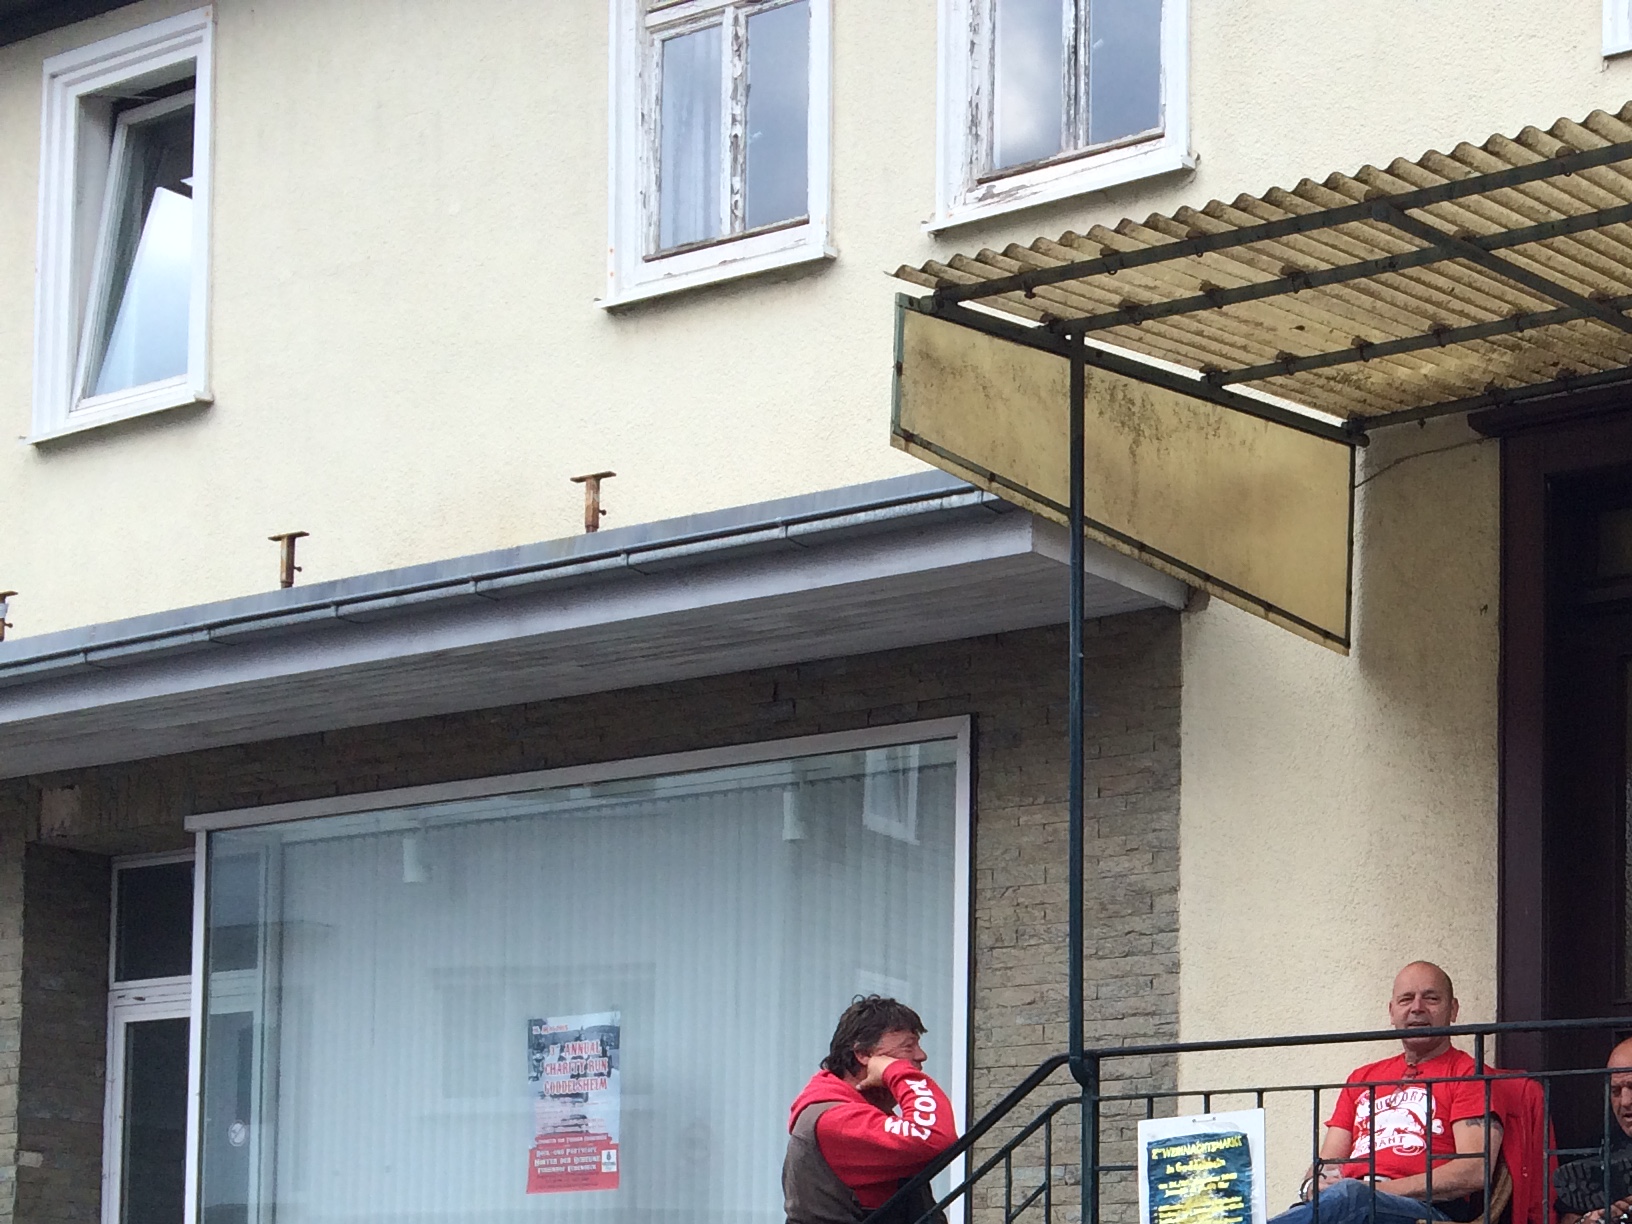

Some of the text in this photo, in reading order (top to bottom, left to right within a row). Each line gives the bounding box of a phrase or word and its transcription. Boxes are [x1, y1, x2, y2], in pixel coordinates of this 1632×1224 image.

[564, 1041, 600, 1056] ANNUAL
[544, 1058, 608, 1076] CHARITY RUN
[1371, 1090, 1427, 1111] UPPORT
